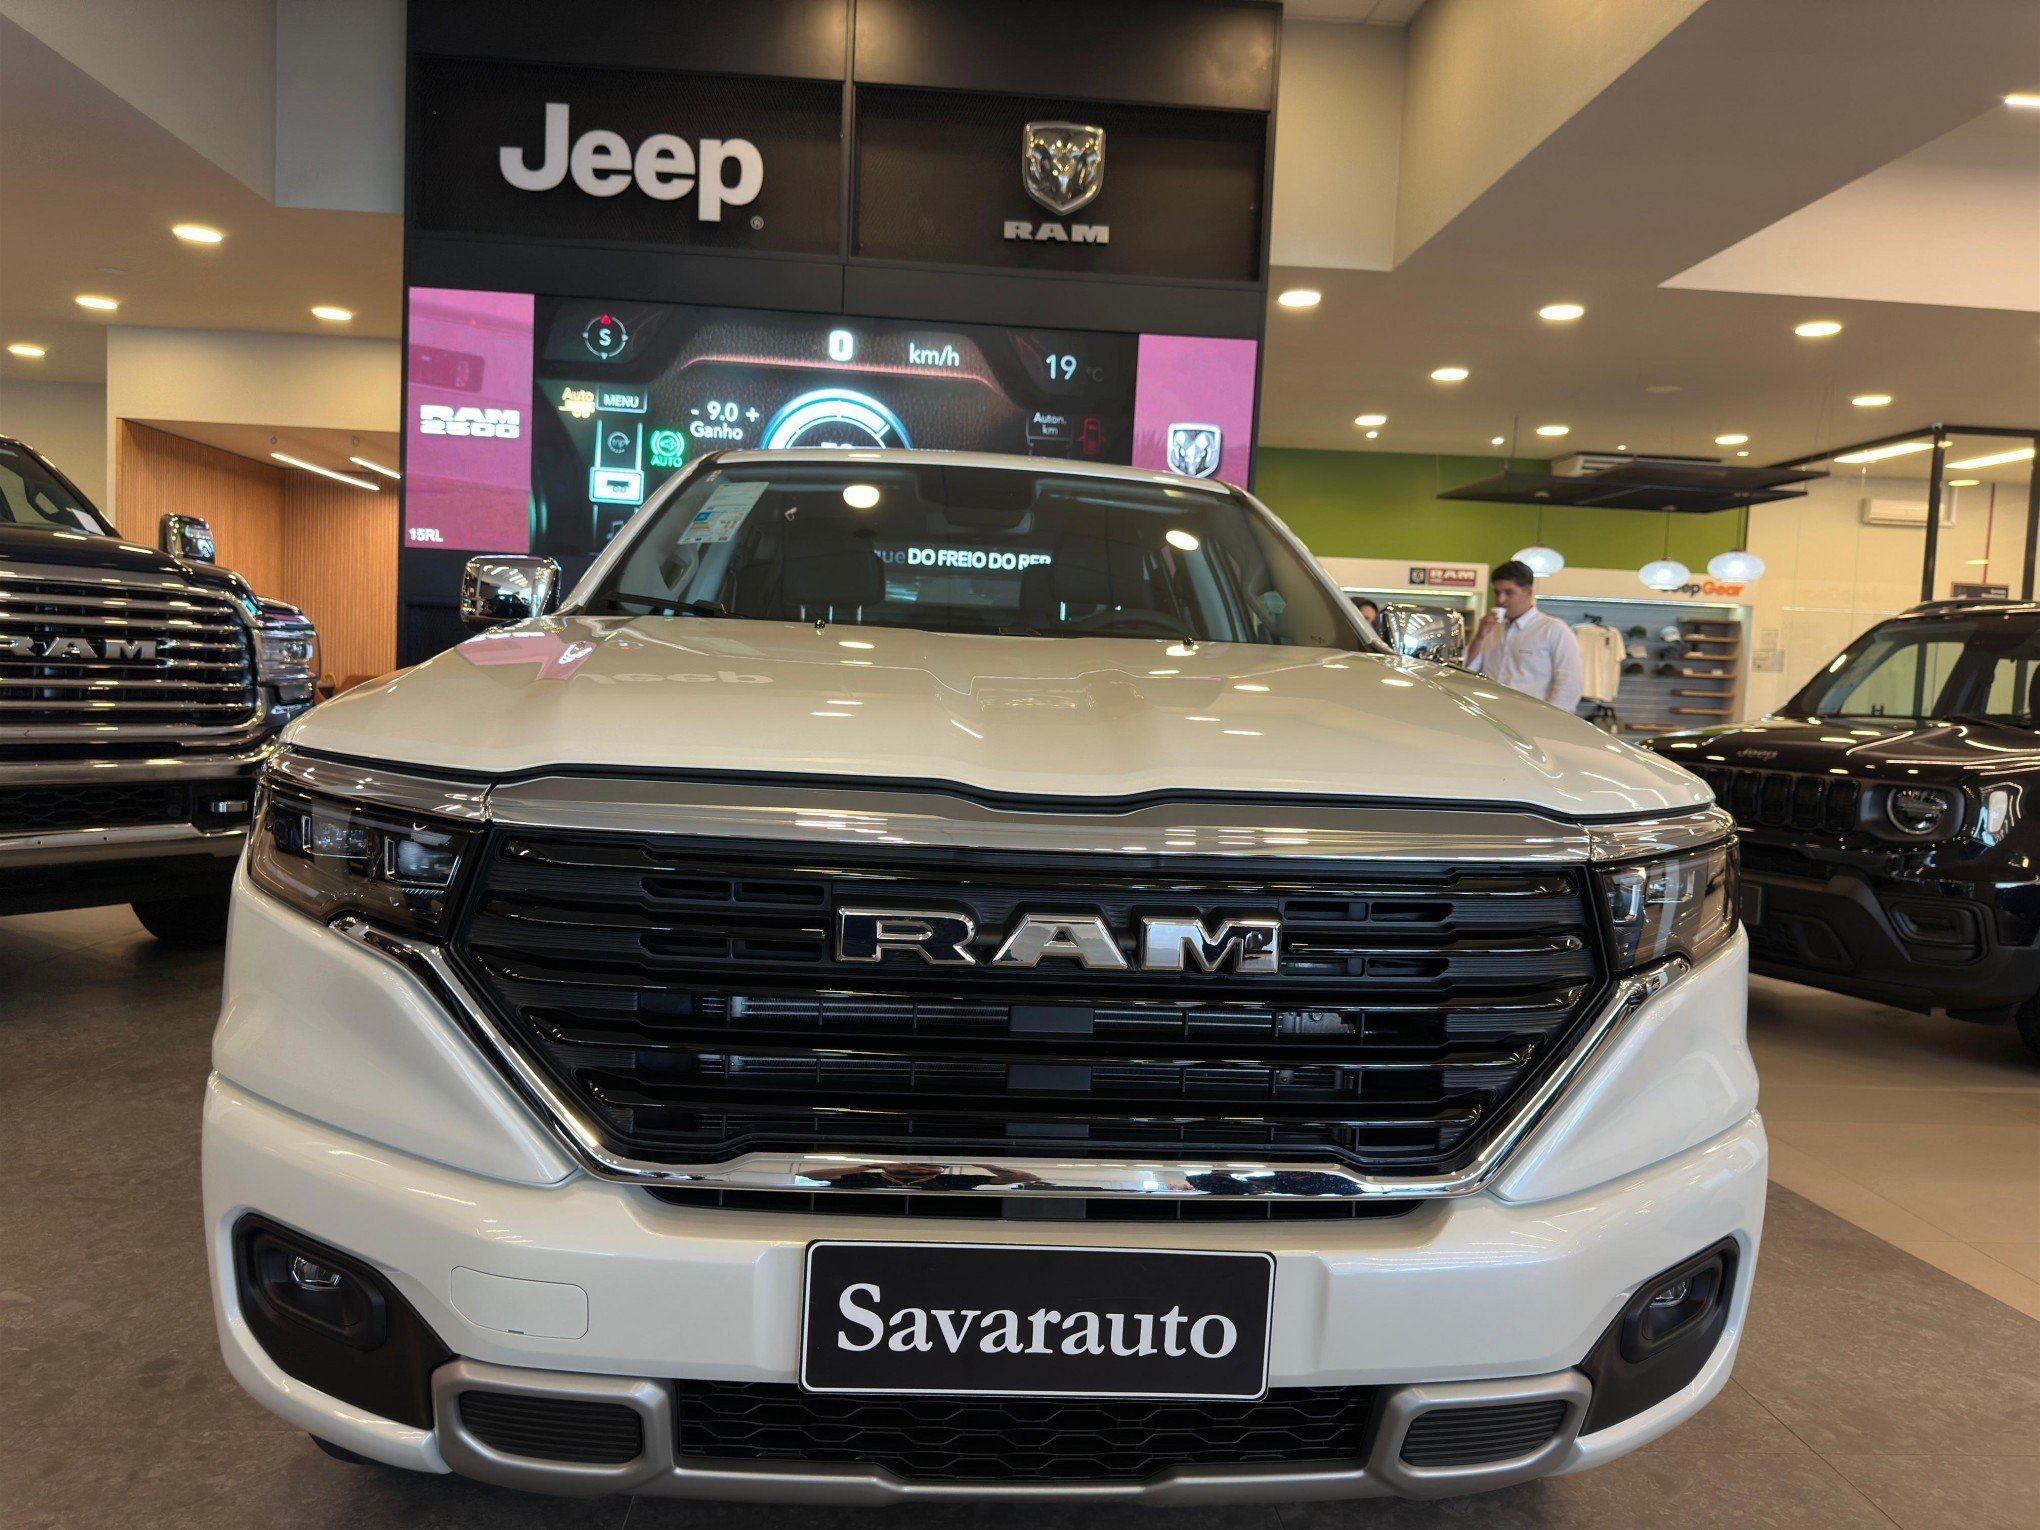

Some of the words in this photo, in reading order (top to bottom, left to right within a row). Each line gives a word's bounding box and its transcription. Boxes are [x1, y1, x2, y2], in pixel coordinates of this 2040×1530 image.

[499, 102, 764, 222] Jeep
[1004, 221, 1110, 244] RAM
[599, 328, 611, 346] S
[908, 342, 960, 367] km/h
[1045, 353, 1077, 380] 19
[562, 387, 595, 401] Auto
[603, 394, 639, 408] MENU
[420, 404, 520, 425] RAM
[420, 419, 521, 439] 2500
[690, 421, 743, 440] Ganho
[1042, 424, 1058, 435] km
[650, 456, 683, 468] AUTO
[408, 527, 444, 543] 15RL
[907, 547, 937, 566] DO
[937, 549, 987, 569] FREIO
[988, 552, 1017, 570] DO
[1429, 568, 1476, 580] RAM
[834, 904, 1284, 974] RAM
[837, 1281, 1239, 1360] Savarauto
